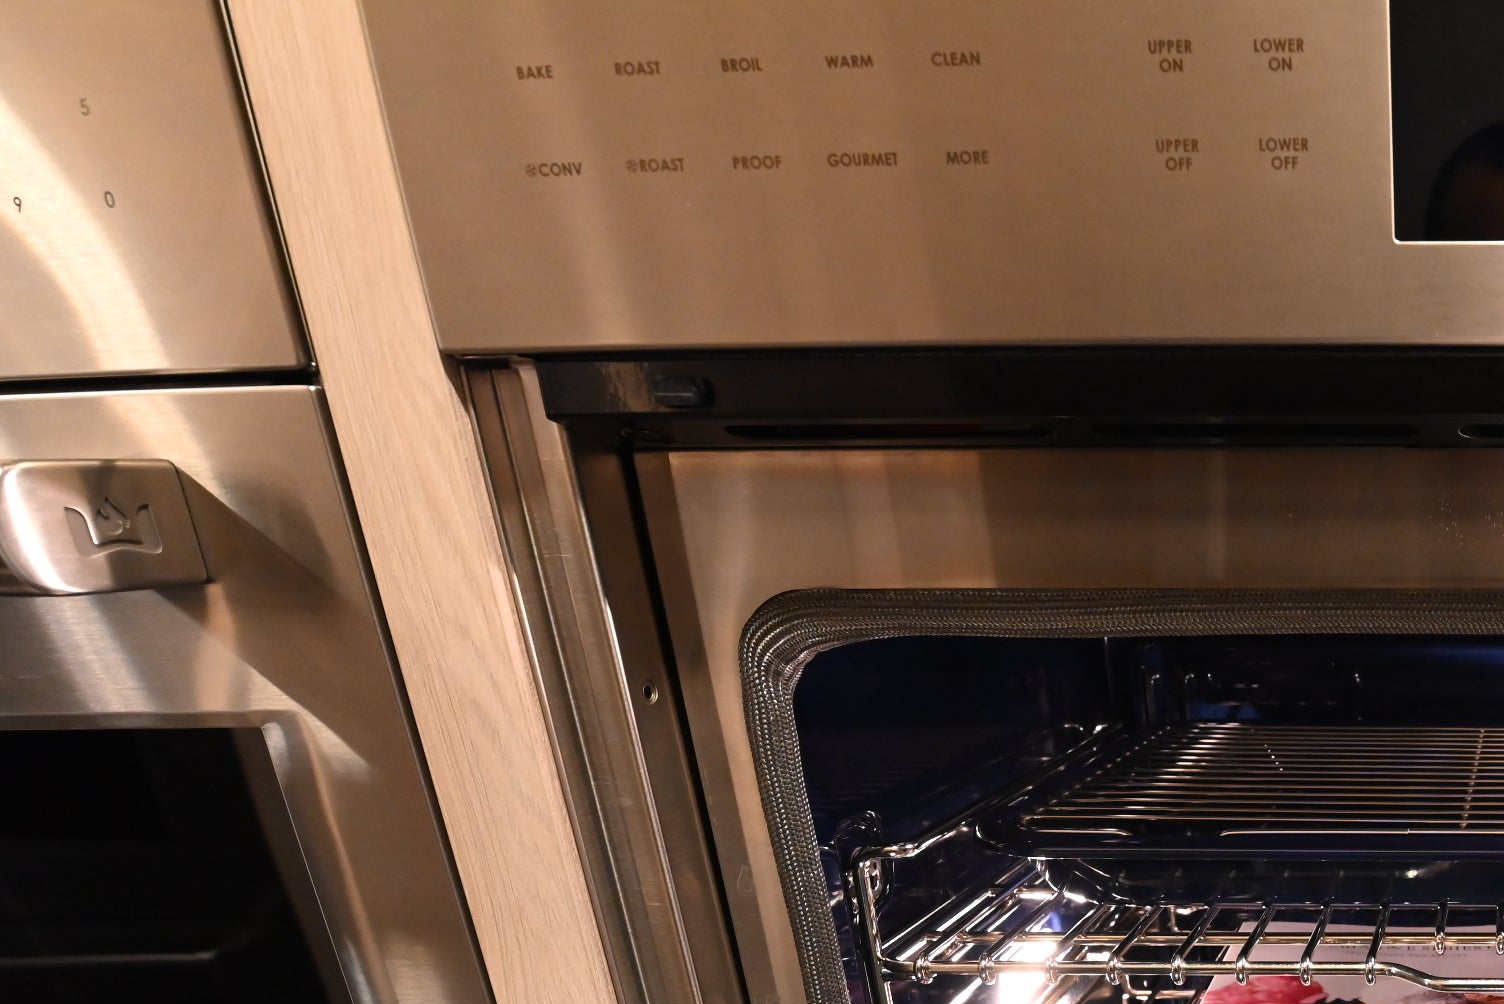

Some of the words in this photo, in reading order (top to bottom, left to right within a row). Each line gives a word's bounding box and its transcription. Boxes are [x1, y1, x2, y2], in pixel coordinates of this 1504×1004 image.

[1147, 39, 1193, 55] UPPER
[1253, 37, 1304, 54] LOWER
[720, 57, 763, 73] BROIL
[824, 54, 874, 69] WARM
[930, 51, 981, 67] CLEAN
[1159, 58, 1184, 73] ON
[1267, 56, 1293, 72] ON
[515, 64, 554, 81] BAKE
[613, 60, 661, 77] ROAST
[79, 97, 91, 117] 5
[1155, 138, 1200, 154] UPPER
[1258, 137, 1309, 153] LOWER
[638, 157, 685, 173] ROAST
[731, 154, 782, 171] PROOF
[826, 151, 898, 168] GOURMET
[945, 149, 990, 166] MORE
[1164, 156, 1193, 172] OFF
[1270, 155, 1299, 171] OFF
[538, 161, 583, 177] CONV
[12, 196, 22, 213] 9
[103, 190, 116, 209] 0
